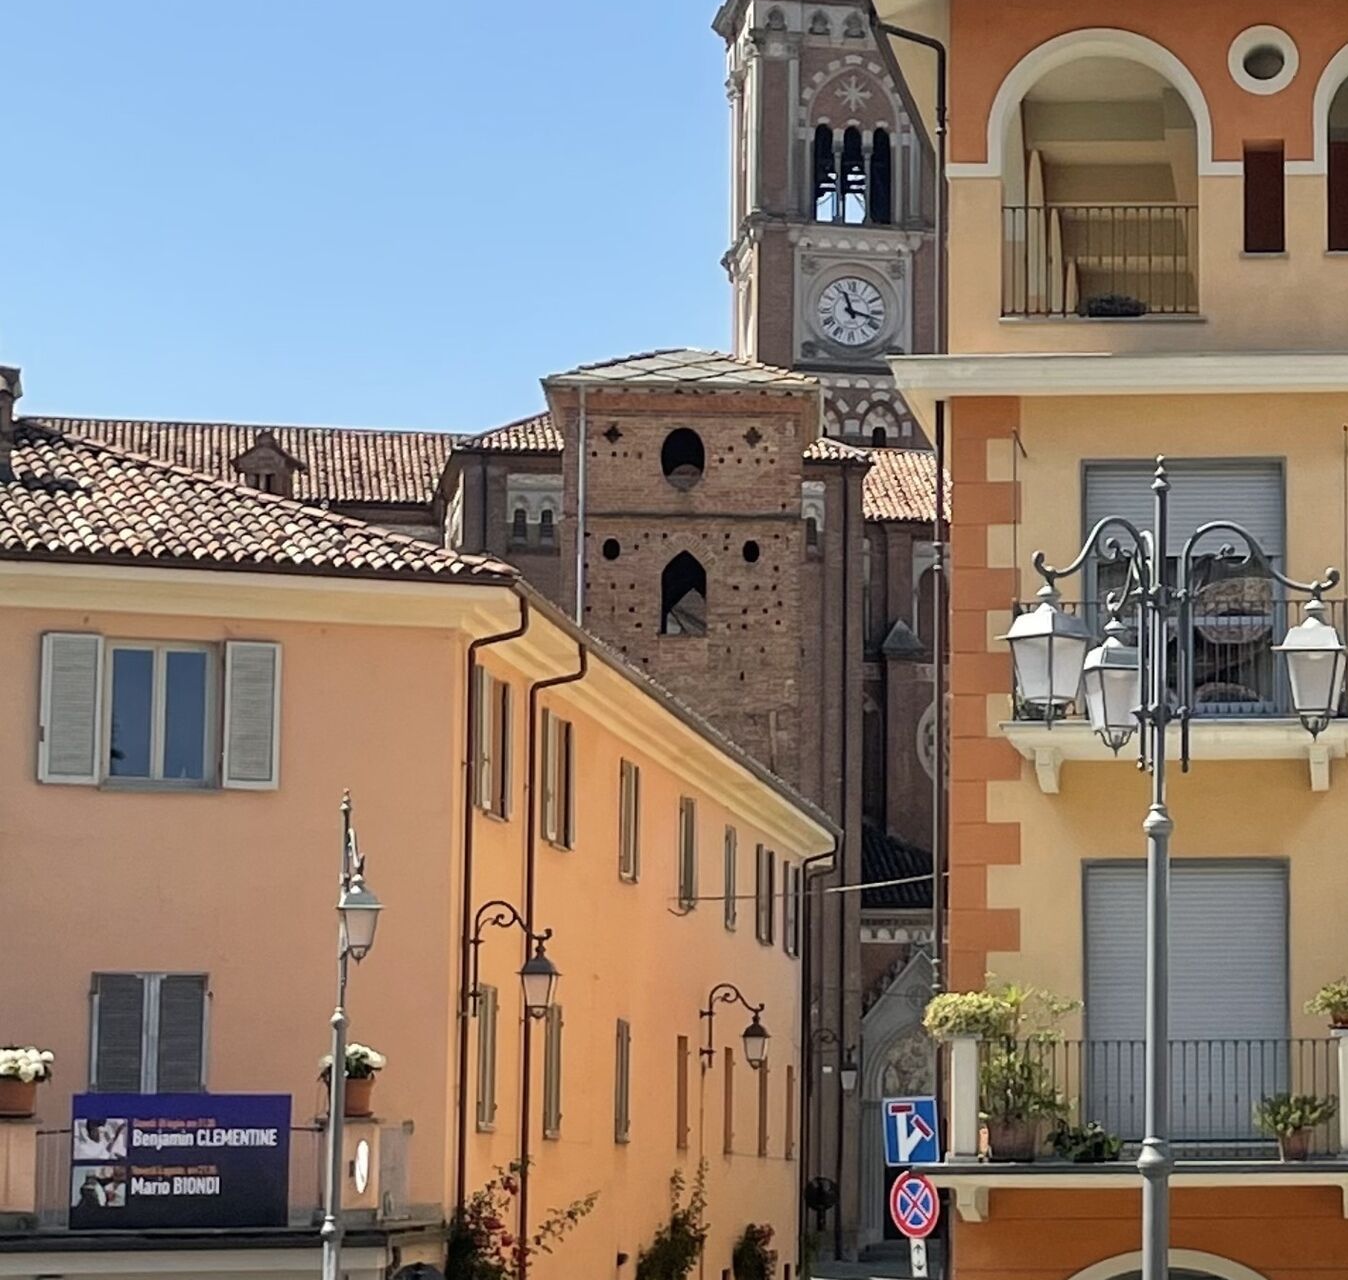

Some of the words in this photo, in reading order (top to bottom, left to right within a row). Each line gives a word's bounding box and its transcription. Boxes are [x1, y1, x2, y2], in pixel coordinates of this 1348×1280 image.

[132, 1128, 194, 1151] Benjamin
[196, 1128, 277, 1147] CLEMENTINE
[130, 1176, 170, 1195] Mario
[172, 1176, 220, 1195] BIONDI
